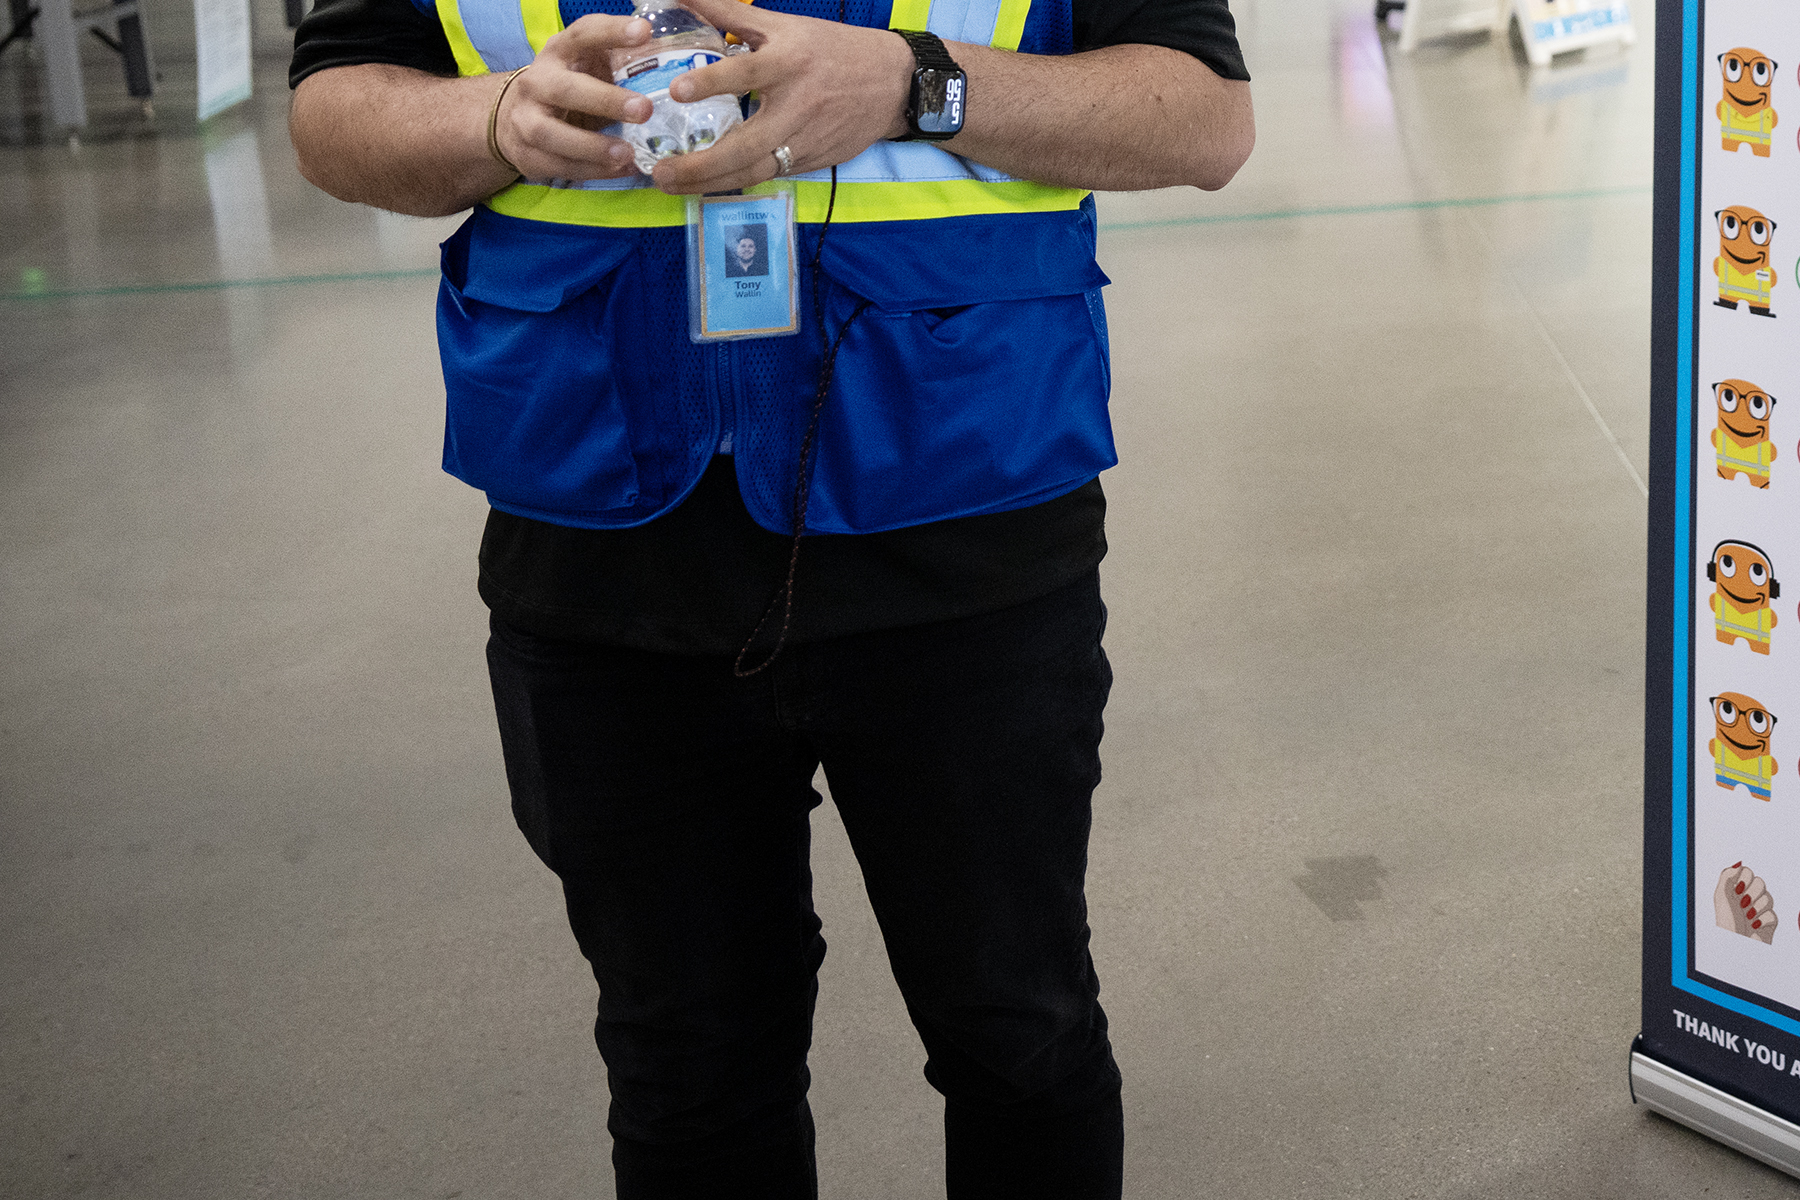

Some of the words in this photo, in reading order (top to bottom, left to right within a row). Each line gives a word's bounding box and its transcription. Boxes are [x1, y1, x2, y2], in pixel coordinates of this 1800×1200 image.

[735, 280, 761, 290] Tony
[735, 290, 762, 298] Wallin
[1673, 1009, 1740, 1054] THANK
[1744, 1039, 1786, 1072] YOU
